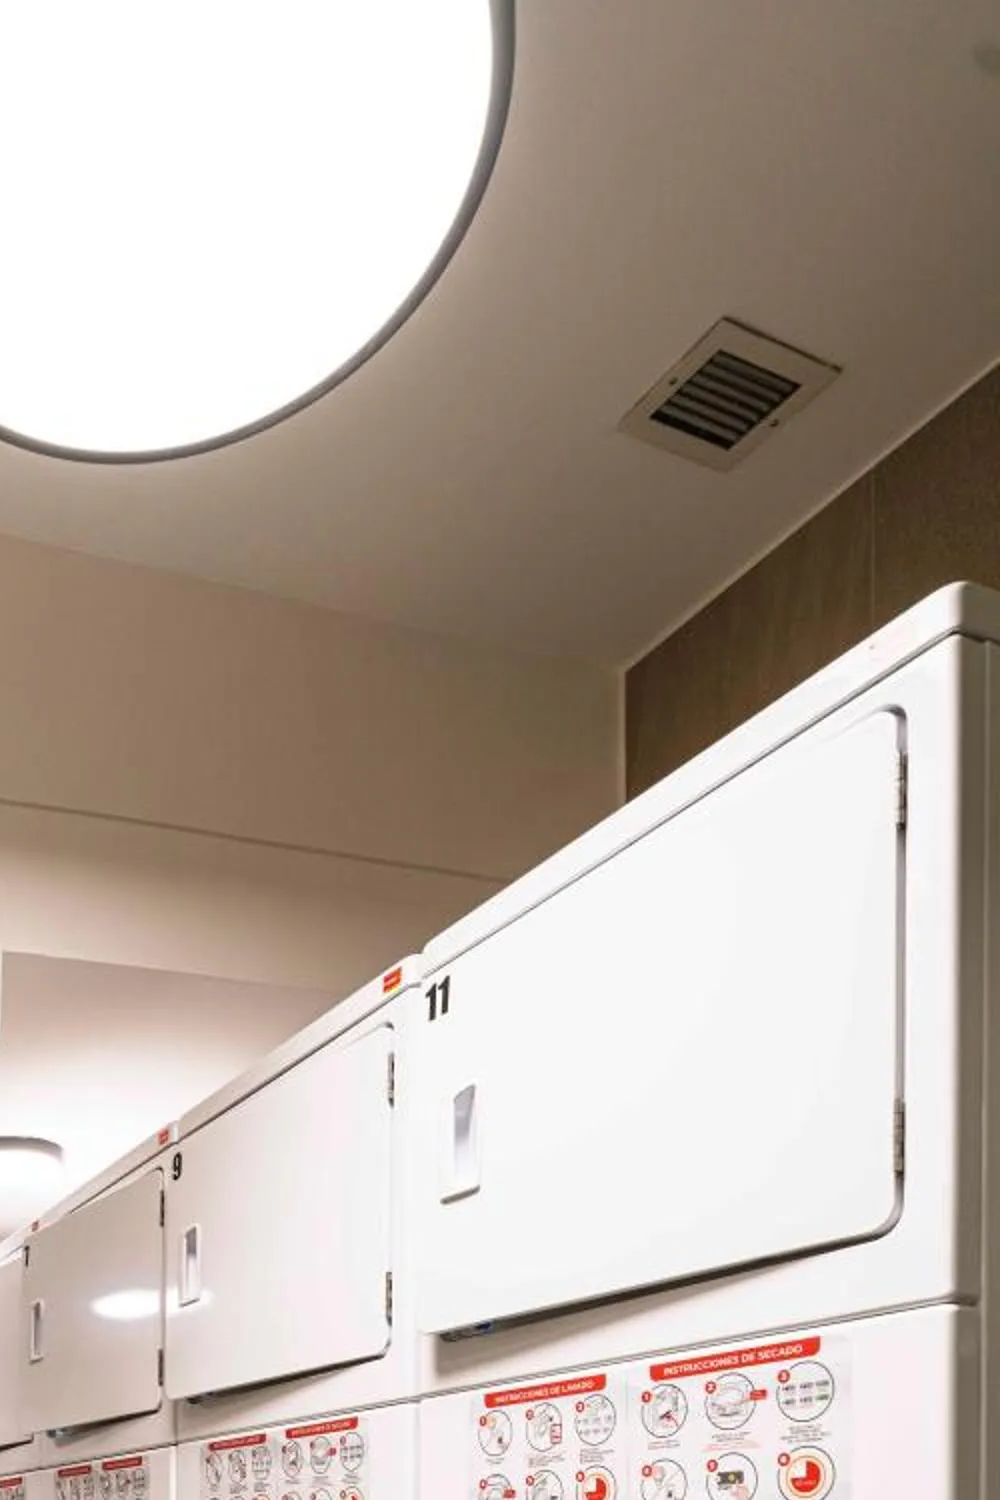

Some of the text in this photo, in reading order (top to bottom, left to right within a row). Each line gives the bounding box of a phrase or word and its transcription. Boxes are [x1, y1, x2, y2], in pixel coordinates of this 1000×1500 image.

[425, 975, 450, 1021] 11
[172, 1152, 182, 1180] 9
[663, 1343, 803, 1377] INSTRUCCIONES DE SECADO
[494, 1387, 549, 1403] INSTRUCCIONES
